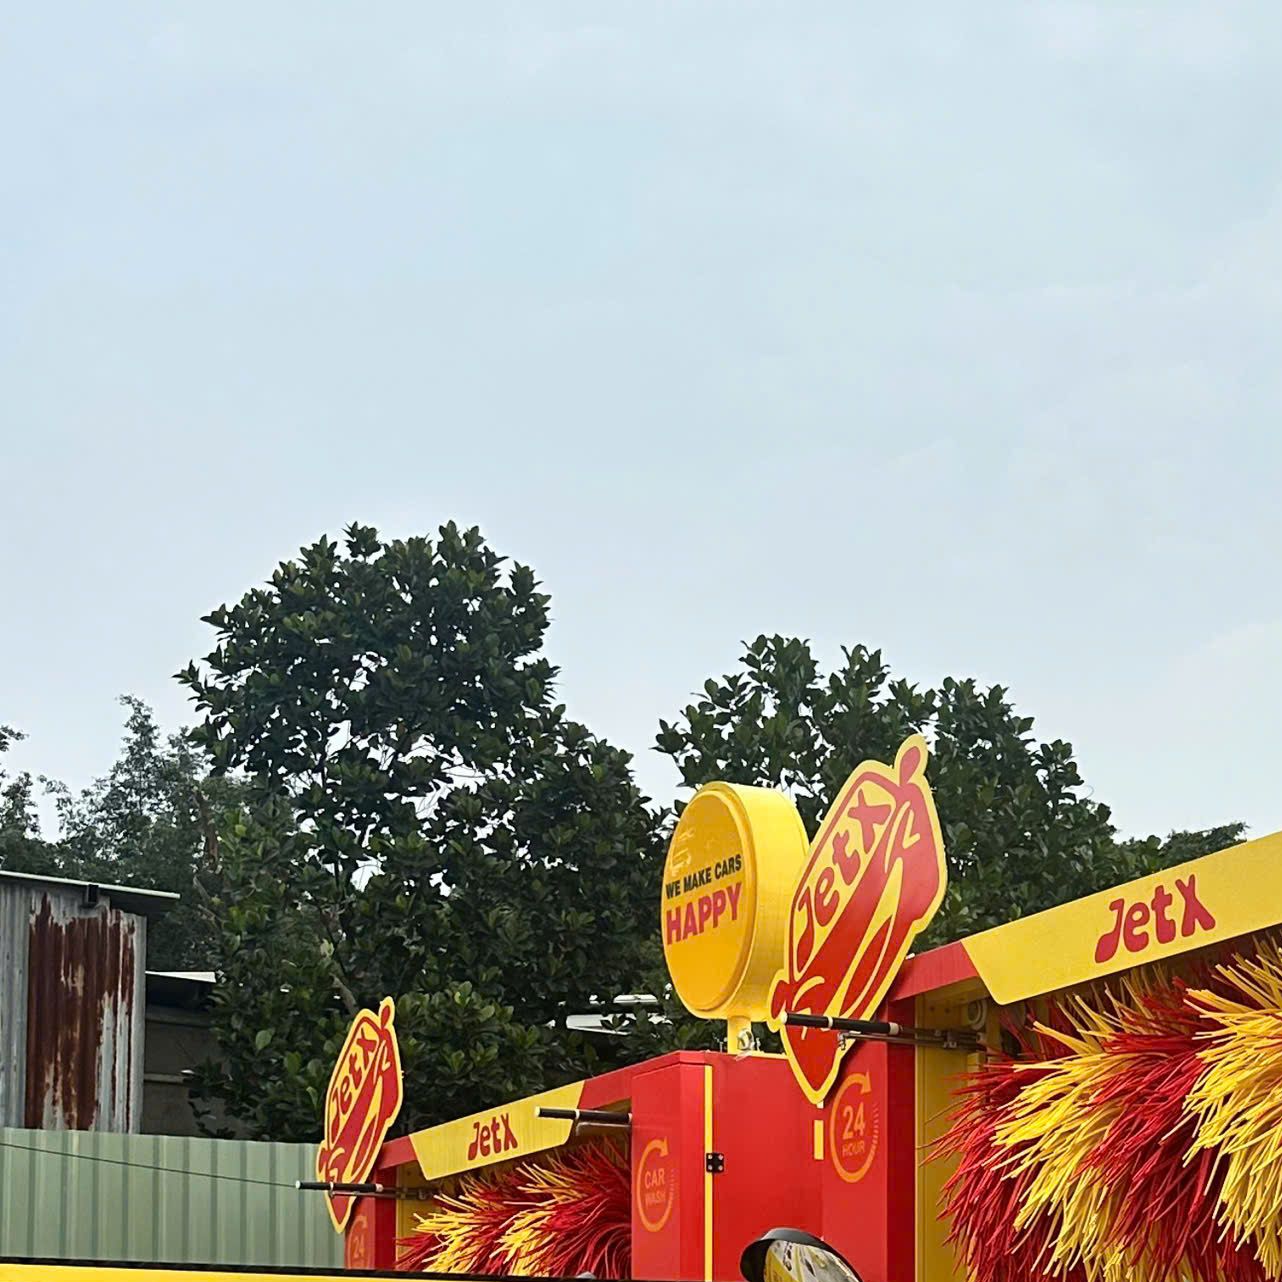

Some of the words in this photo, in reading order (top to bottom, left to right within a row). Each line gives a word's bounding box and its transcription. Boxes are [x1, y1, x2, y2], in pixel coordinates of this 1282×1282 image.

[666, 880, 680, 899] WE
[684, 867, 712, 893] MAKE
[715, 854, 741, 879] CARS
[796, 789, 891, 967] JetX
[667, 882, 741, 945] HAPPY
[1095, 874, 1216, 963] JetX
[331, 1027, 377, 1144] JetX
[468, 1113, 518, 1161] JetX
[843, 1102, 865, 1140] 24
[842, 1140, 864, 1157] HOUR
[645, 1168, 665, 1189] CAR
